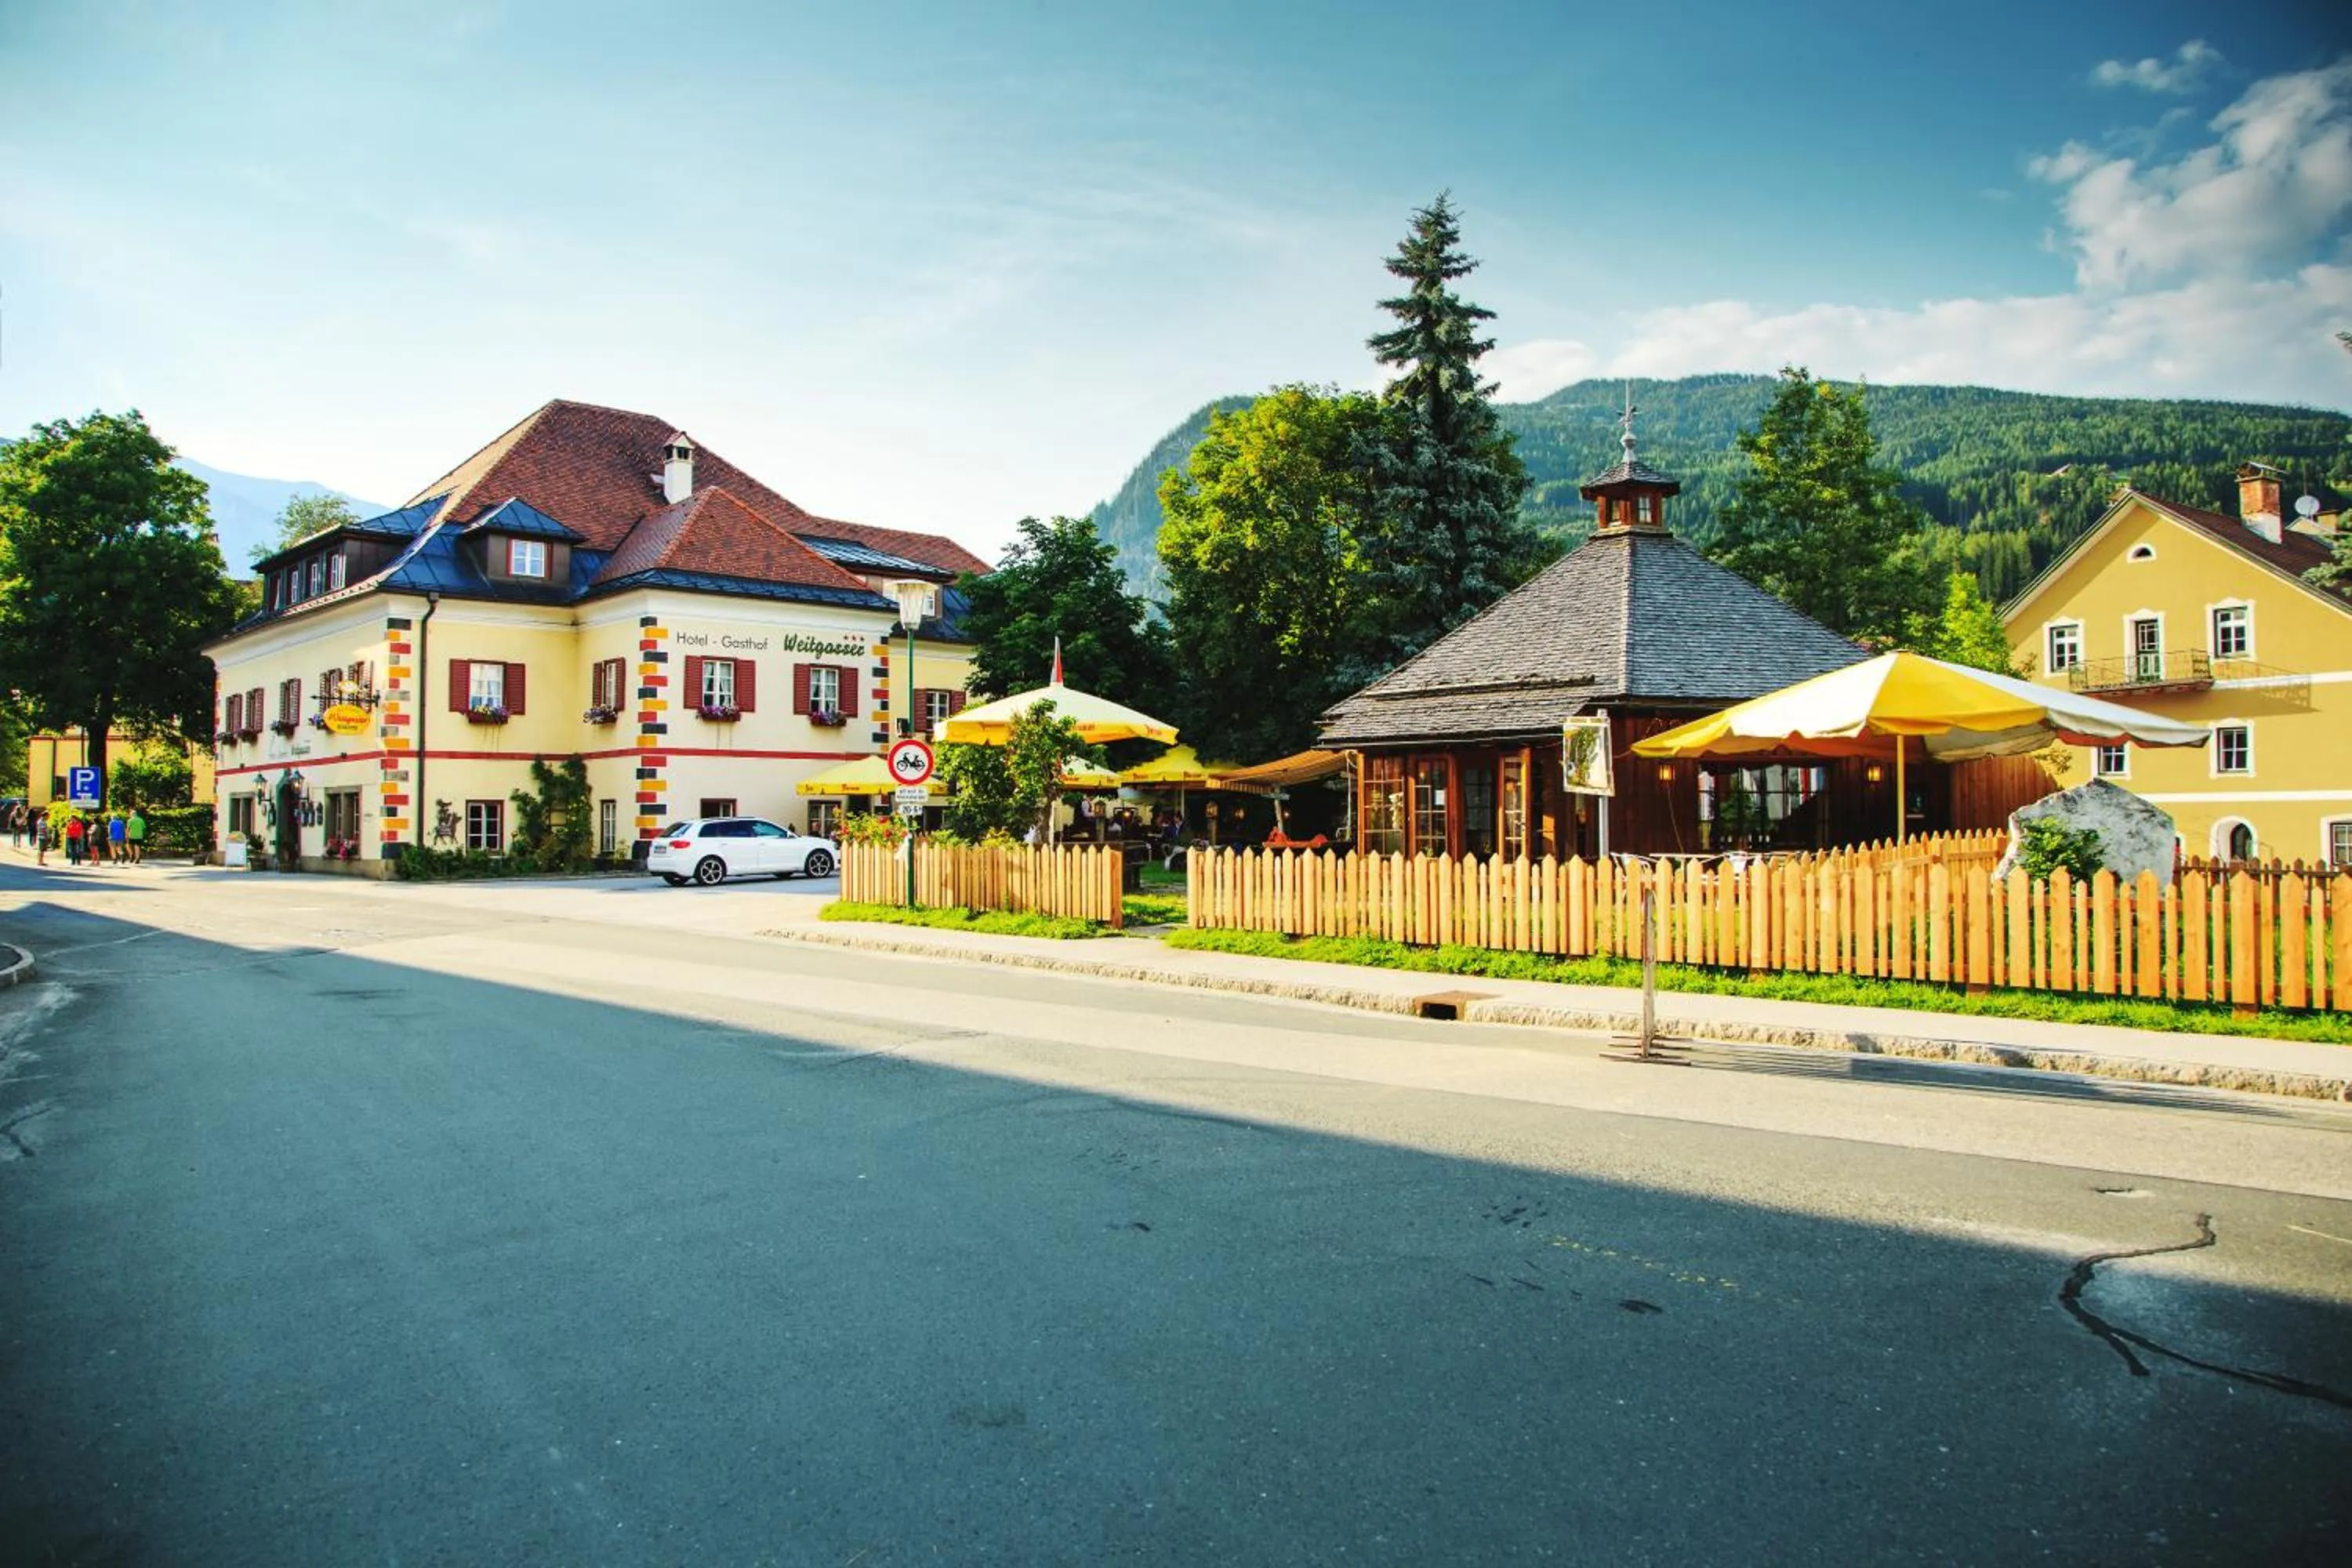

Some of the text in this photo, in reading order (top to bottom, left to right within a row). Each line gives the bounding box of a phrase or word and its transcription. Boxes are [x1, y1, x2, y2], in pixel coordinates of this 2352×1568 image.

[677, 630, 708, 647] Hotel
[721, 634, 768, 650] Gasthof
[784, 633, 865, 659] Weitgasser
[76, 769, 95, 791] P
